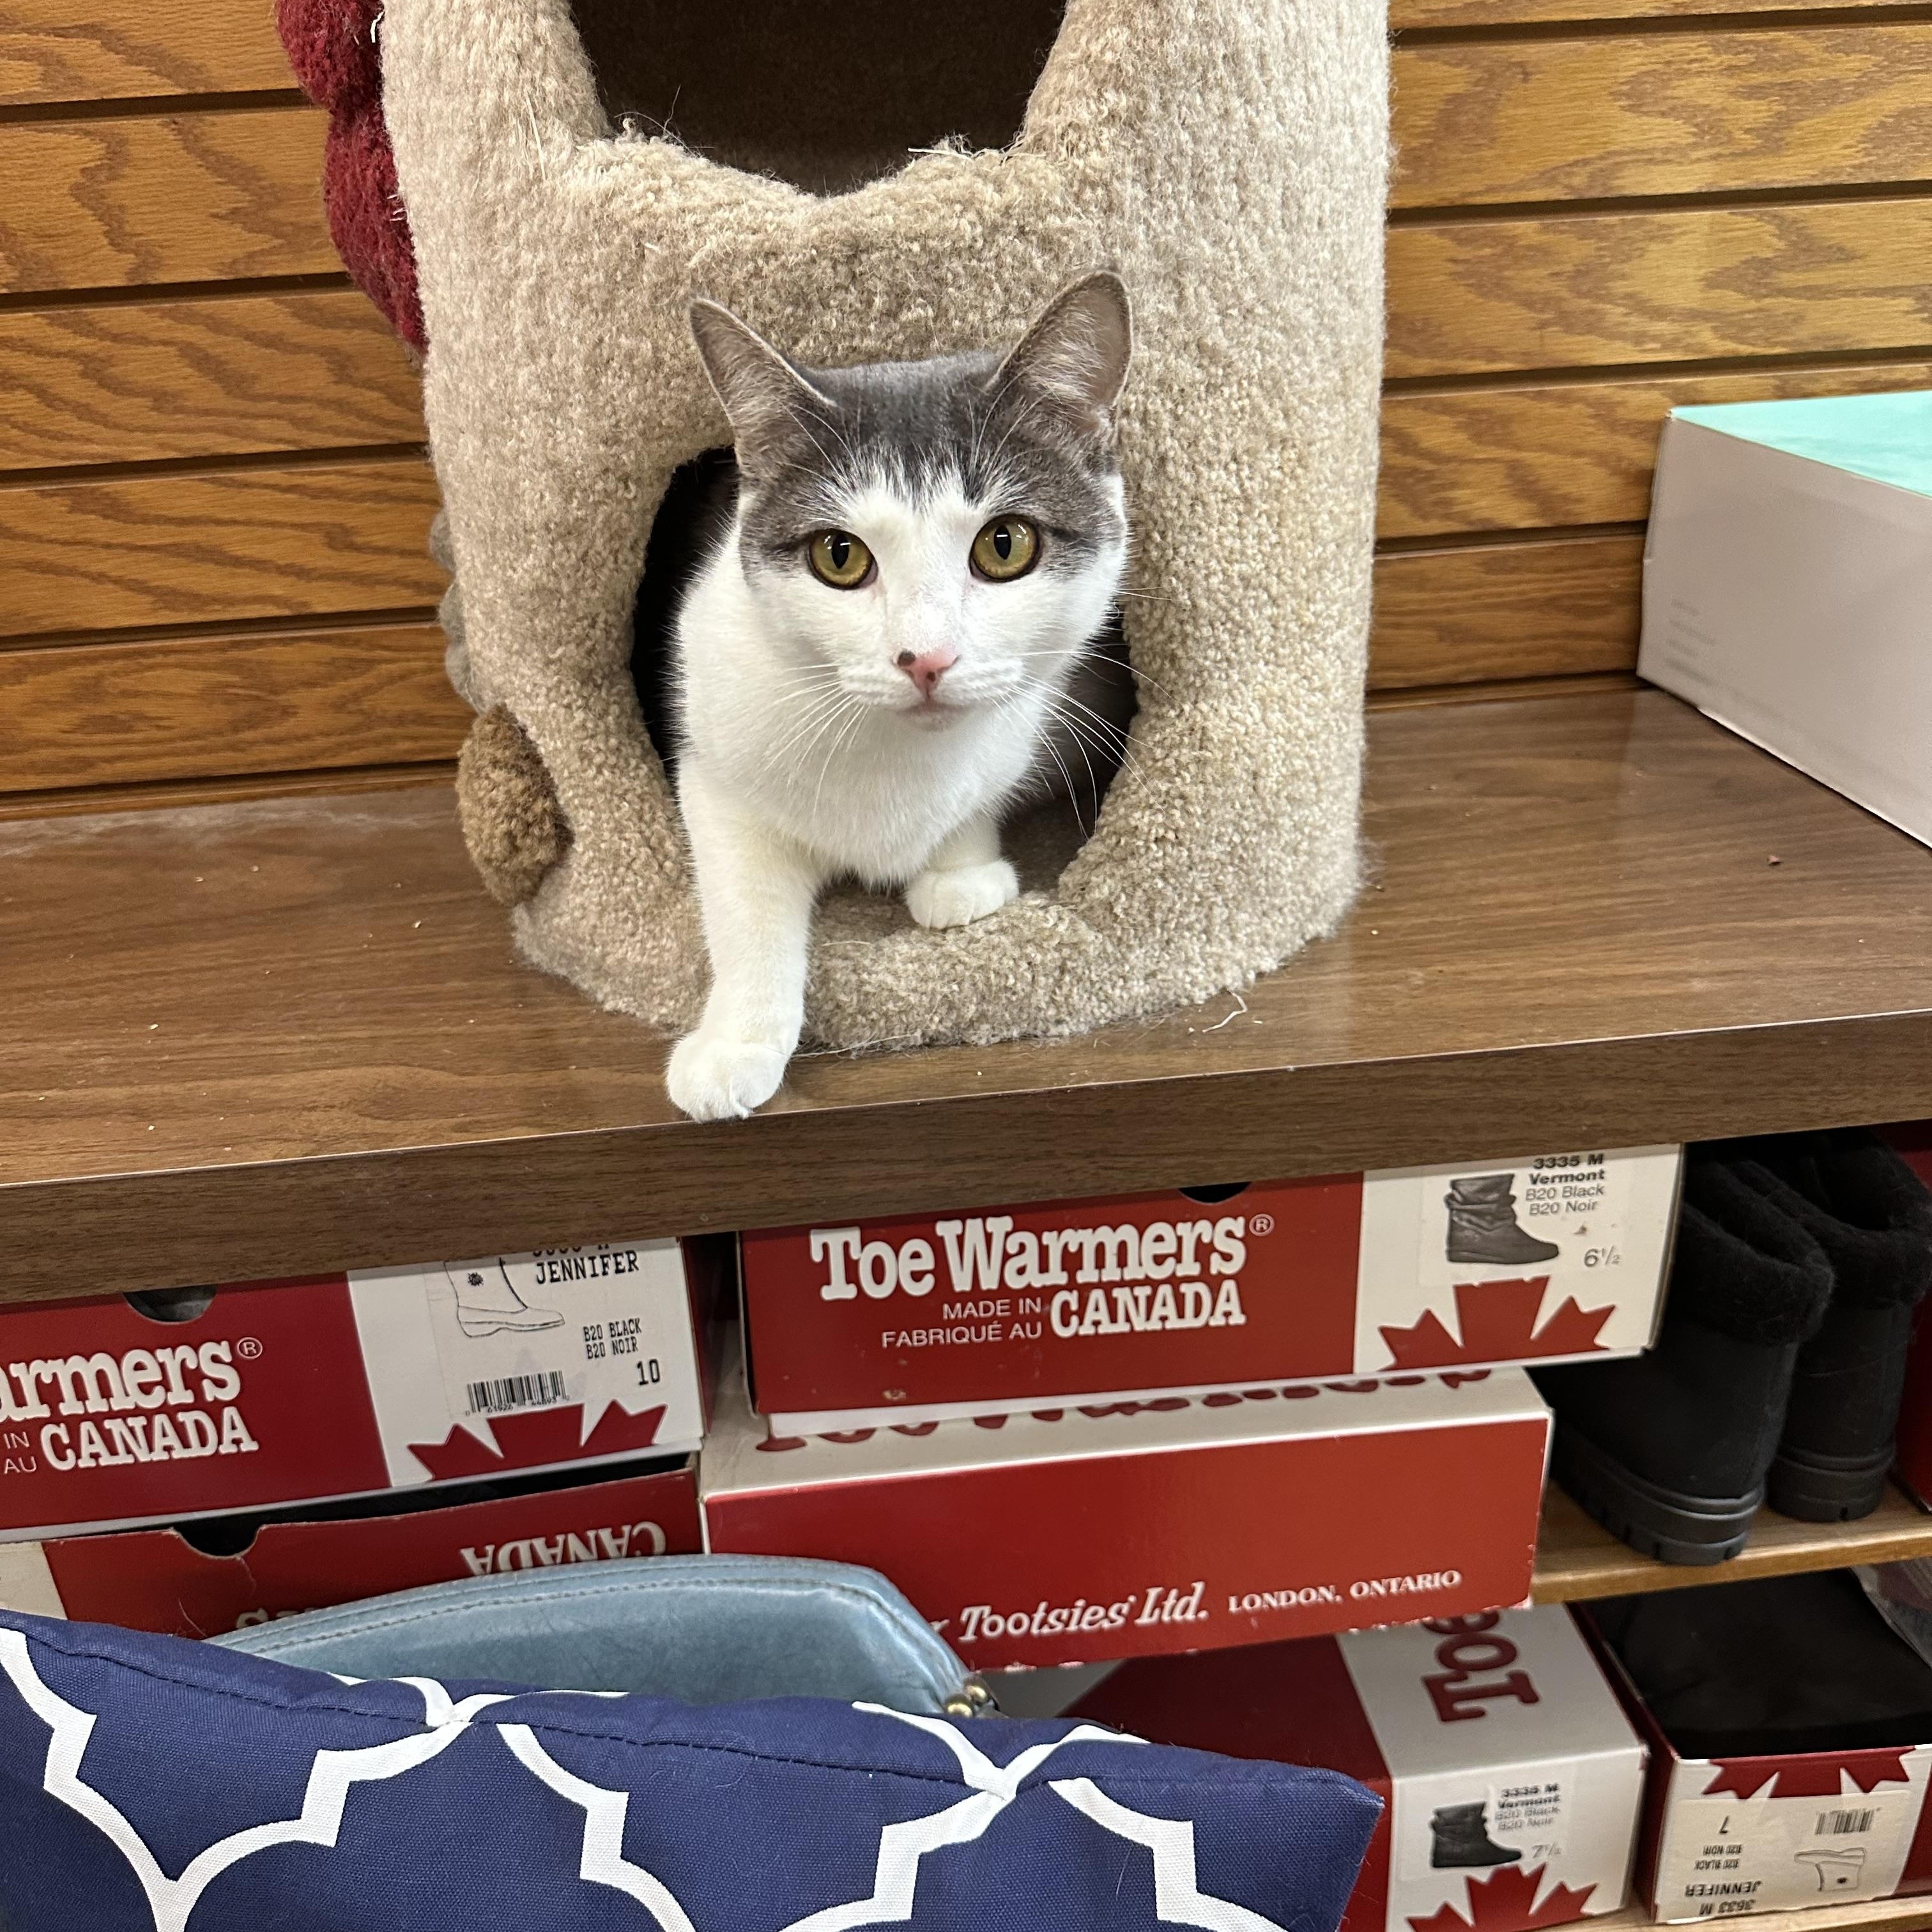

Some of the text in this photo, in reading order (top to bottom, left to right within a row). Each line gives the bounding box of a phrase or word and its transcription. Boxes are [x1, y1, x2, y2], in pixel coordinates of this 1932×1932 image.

[1533, 1153, 1604, 1169] 3335 M
[1529, 1169, 1605, 1184] Vermont
[1526, 1184, 1605, 1200] B20 Black
[1529, 1200, 1598, 1215] B20 Noir
[536, 1250, 639, 1284] JENNIFER
[809, 1226, 935, 1301] Toe
[942, 1278, 1246, 1337] MADE IN CANADA
[583, 1317, 642, 1342] B20 BLACK
[881, 1320, 1042, 1349] FABRIQUÉ AU
[586, 1336, 639, 1360] B20 NOIR
[636, 1358, 661, 1386] 10
[3, 1406, 259, 1471] IN CANADA
[3, 1455, 37, 1475] AU
[460, 1521, 666, 1577] CANADA
[1134, 1581, 1211, 1627] Ltd.
[1228, 1584, 1342, 1614] LONDON,
[1349, 1570, 1462, 1599] ONTARIO
[1498, 1795, 1560, 1809] Vermont
[1524, 1806, 1561, 1816] Black
[1526, 1817, 1554, 1827] Noir
[1719, 1815, 1729, 1835] 7
[1703, 1844, 1724, 1856] NOIR
[1694, 1859, 1721, 1871] BLACK
[1685, 1880, 1761, 1897] JENNIFER
[1699, 1903, 1714, 1915] M
